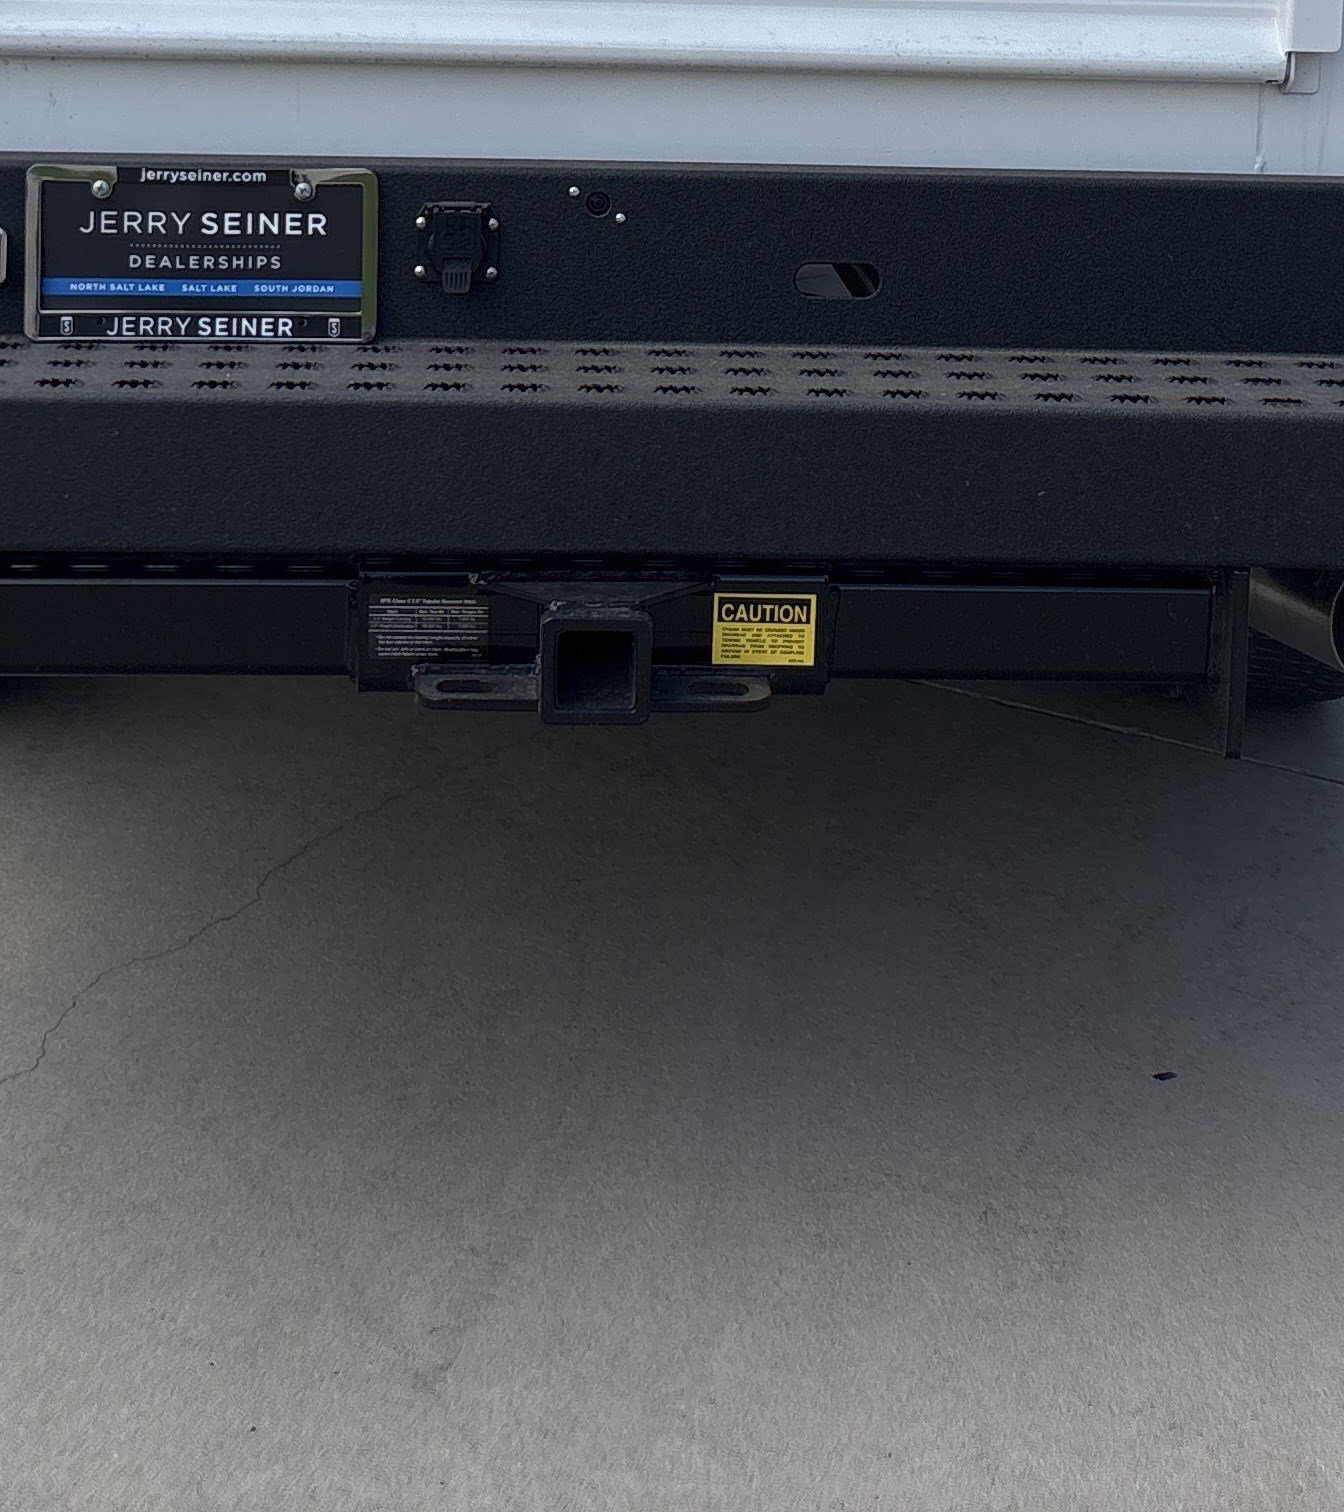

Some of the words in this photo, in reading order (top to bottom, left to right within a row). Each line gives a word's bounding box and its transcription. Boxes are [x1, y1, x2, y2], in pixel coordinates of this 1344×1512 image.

[140, 167, 267, 184] jerryseiner.com
[79, 210, 192, 236] JERRY
[201, 212, 327, 236] SEINER
[129, 254, 282, 270] DEALERSHIPS
[70, 283, 106, 291] NORTH
[109, 283, 135, 292] SALT
[138, 283, 165, 292] LAKE
[182, 284, 207, 293] SALT
[210, 284, 237, 293] LAKE
[254, 284, 289, 293] SOUTH
[291, 284, 335, 293] JORDAN
[107, 316, 192, 336] JERRY
[197, 317, 293, 337] SEINER
[721, 603, 808, 623] CAUTION
